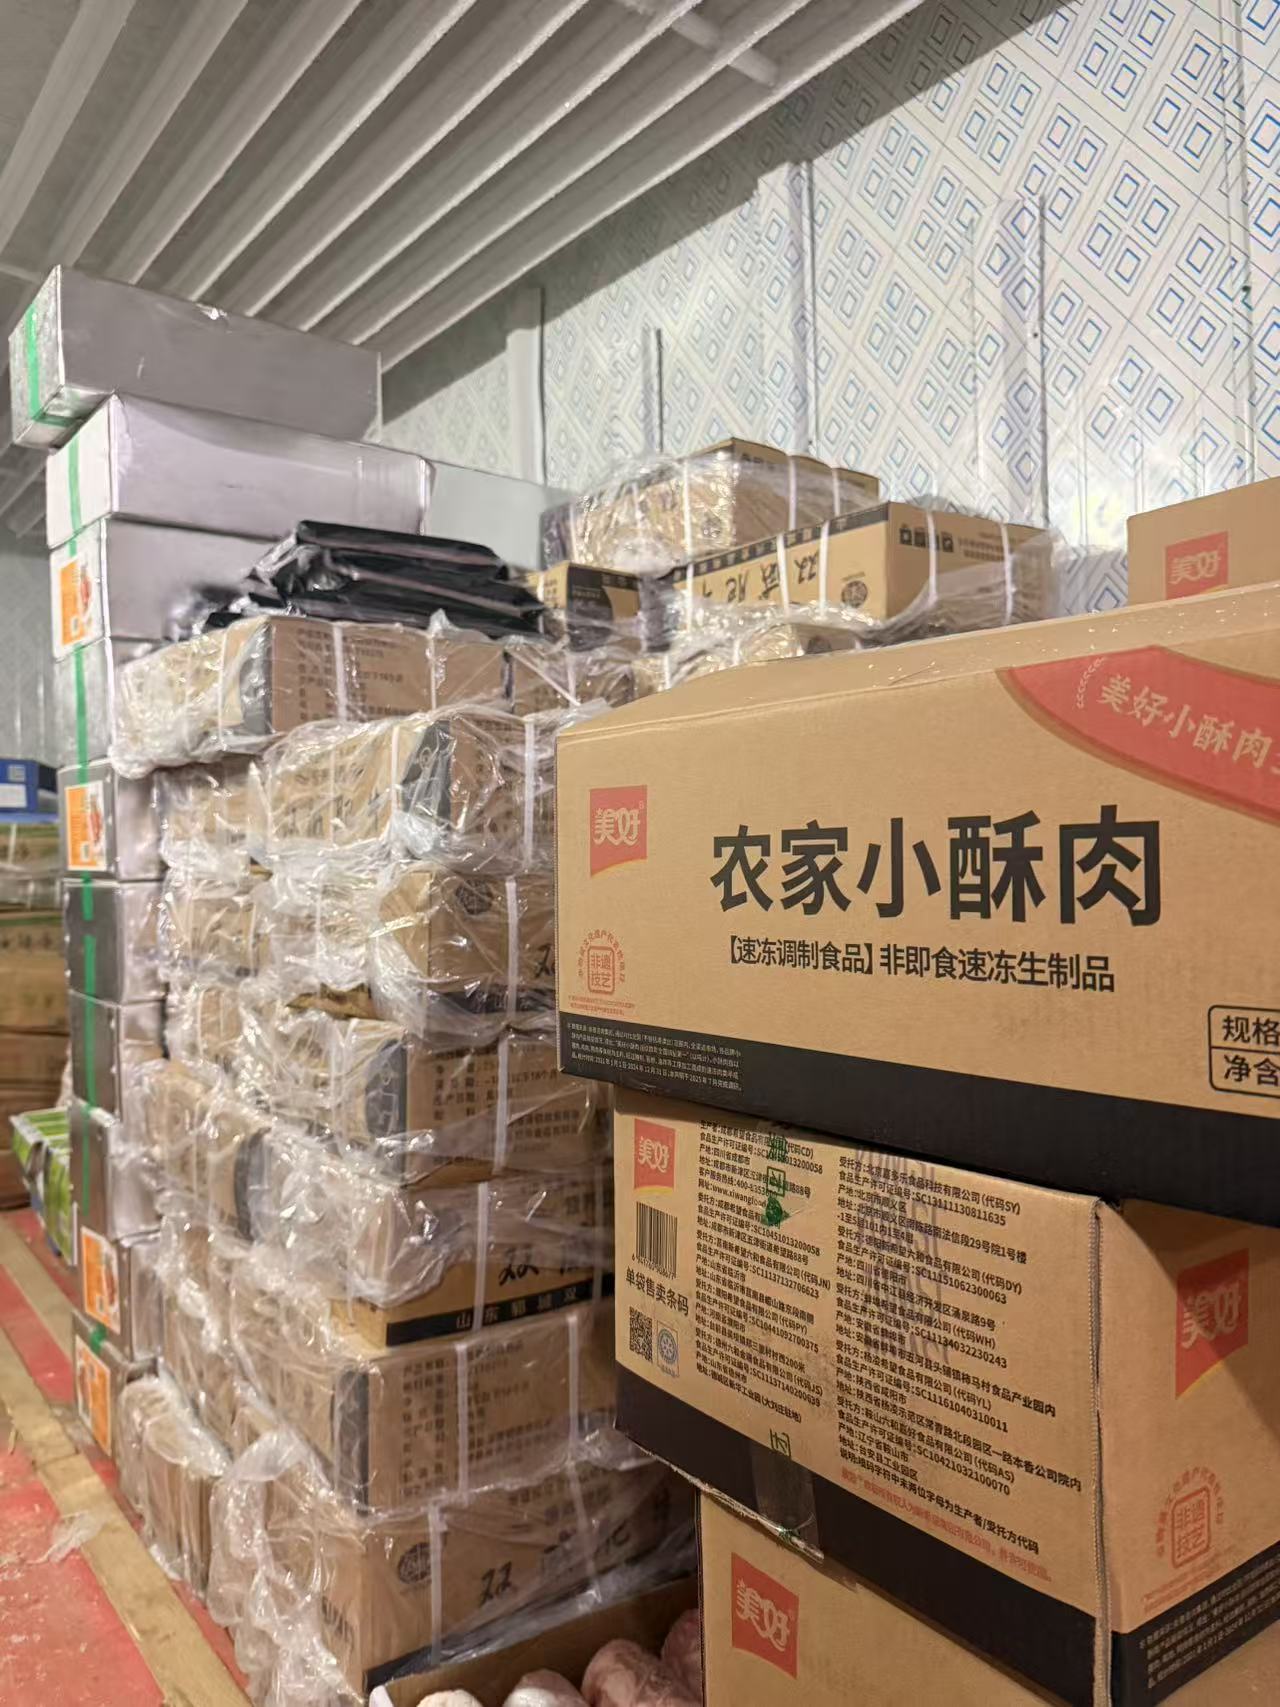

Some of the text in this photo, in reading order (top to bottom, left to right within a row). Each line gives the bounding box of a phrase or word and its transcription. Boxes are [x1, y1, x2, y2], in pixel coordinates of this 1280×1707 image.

[1170, 551, 1220, 585] 美好
[593, 808, 640, 846] 美好
[710, 804, 1161, 927] 农家小酥肉
[1222, 1015, 1280, 1047] 规格
[1223, 1055, 1280, 1087] 净含
[637, 1135, 670, 1174] 美好
[836, 1253, 908, 1285] 产地:四川省德阳市
[626, 1266, 689, 1317] 单袋售卖条码
[835, 1310, 906, 1346] 产地:安徽省蚌埠市
[1181, 1279, 1242, 1349] 美好
[836, 1367, 907, 1405] 产地:陕西省咸阳市
[838, 1422, 909, 1463] 产地:辽宁省鞍山市
[839, 1435, 919, 1482] 地址:台安县工业园区
[735, 1578, 791, 1652] 美好
